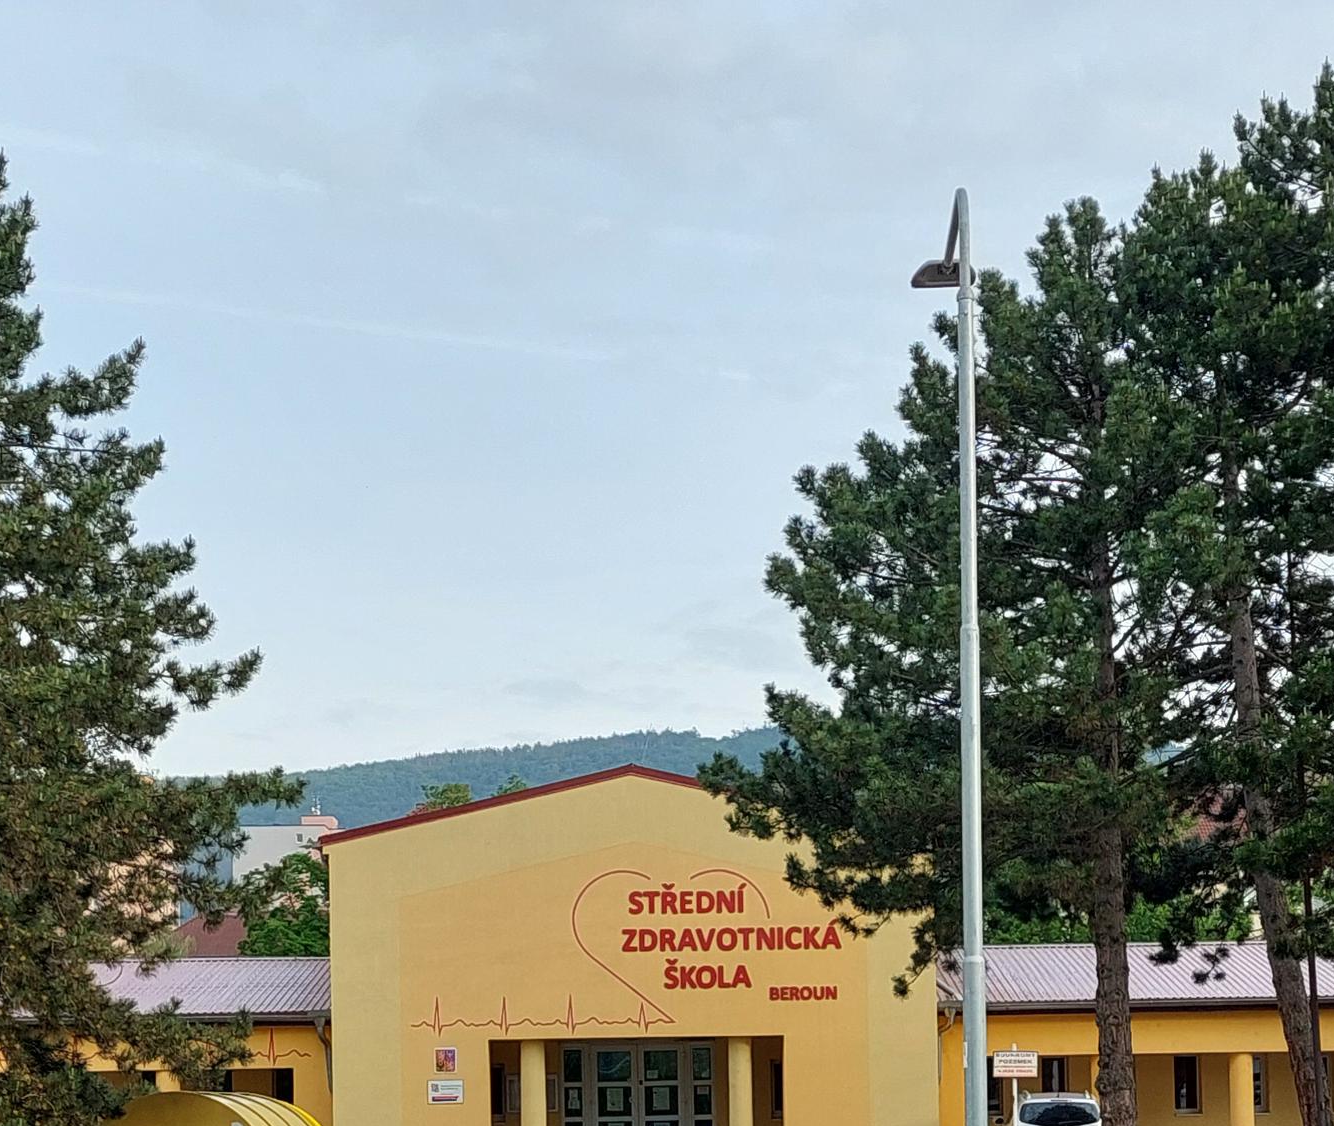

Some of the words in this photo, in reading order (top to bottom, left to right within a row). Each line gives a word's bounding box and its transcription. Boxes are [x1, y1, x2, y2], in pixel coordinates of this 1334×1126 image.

[628, 882, 747, 915] STŘEDNÍ
[621, 918, 842, 953] ZDRAVOTNICKÁ
[663, 958, 753, 990] ŠKOLA
[769, 985, 838, 1001] BEROUN
